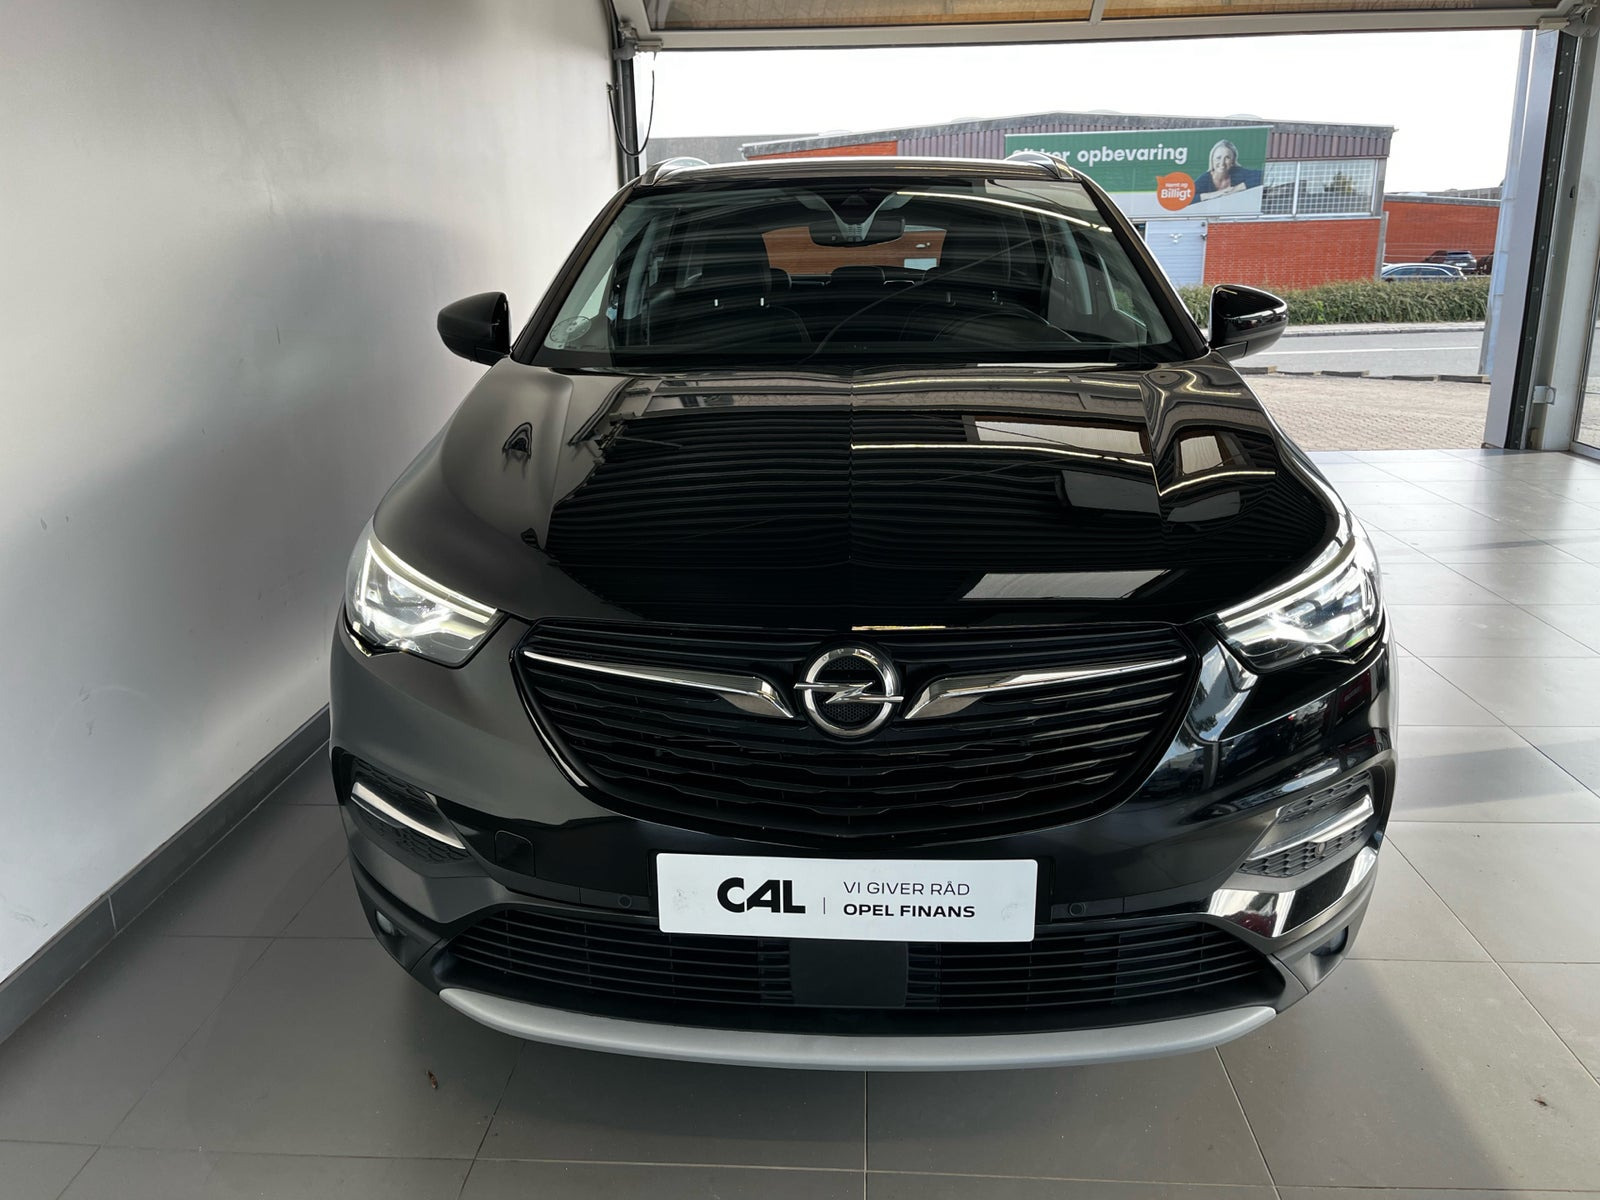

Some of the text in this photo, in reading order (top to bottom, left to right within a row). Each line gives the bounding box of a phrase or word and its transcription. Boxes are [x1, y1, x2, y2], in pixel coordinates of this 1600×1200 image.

[1077, 144, 1188, 167] opbevaring
[1161, 188, 1191, 201] Billigt
[717, 877, 806, 914] CAL
[843, 881, 970, 896] VI GIVER RÅD
[843, 903, 976, 918] OPEL FINANS
